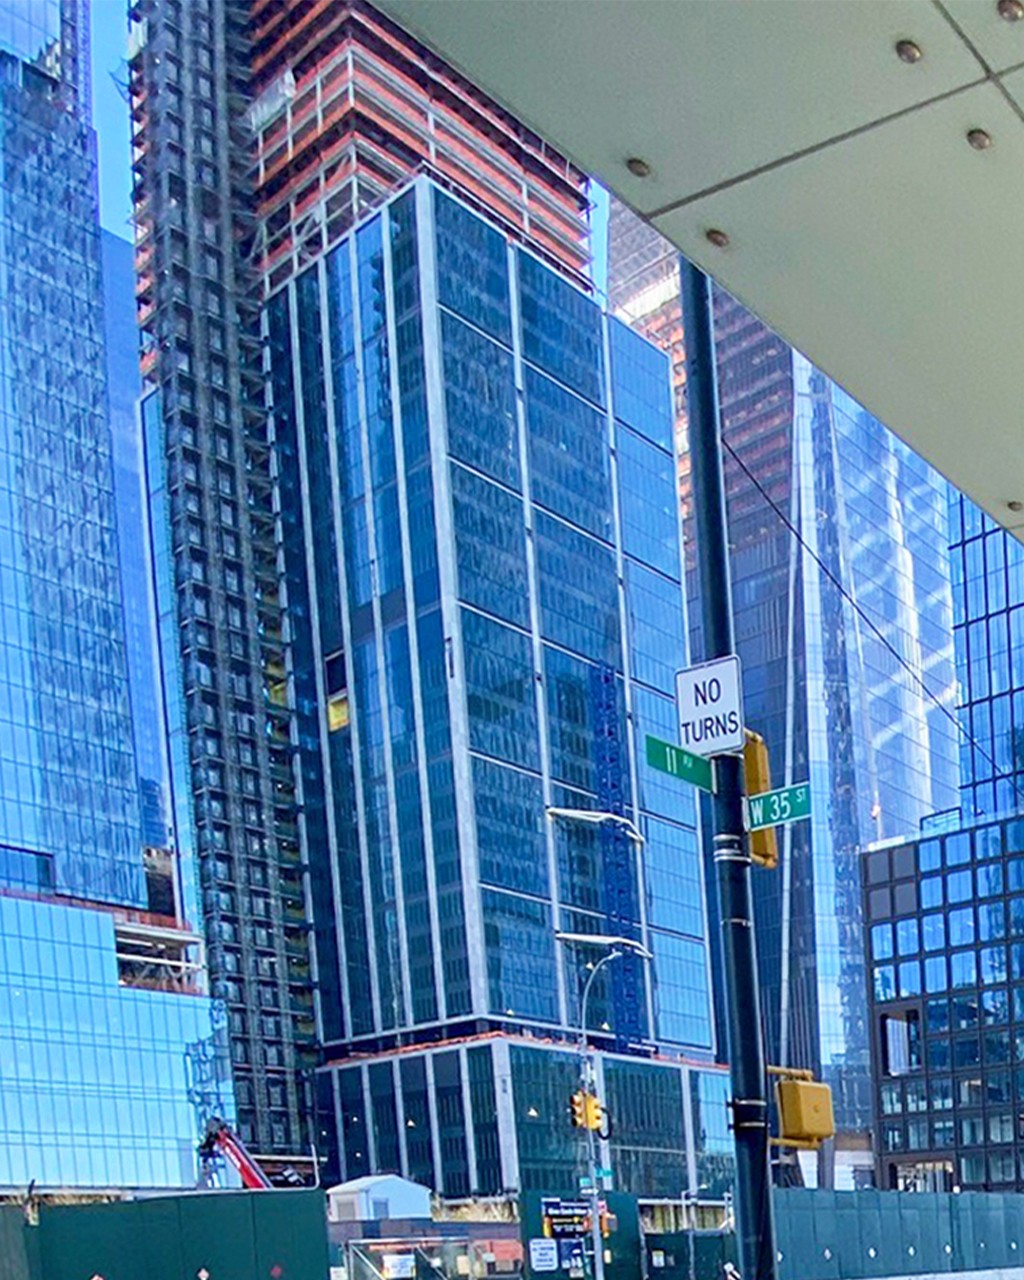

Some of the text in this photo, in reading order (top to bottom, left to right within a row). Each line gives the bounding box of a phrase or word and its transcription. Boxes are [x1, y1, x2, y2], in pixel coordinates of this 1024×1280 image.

[693, 678, 721, 707] NO
[681, 710, 739, 745] TURNS
[665, 746, 677, 774] 11
[750, 788, 806, 825] W 35 ST
